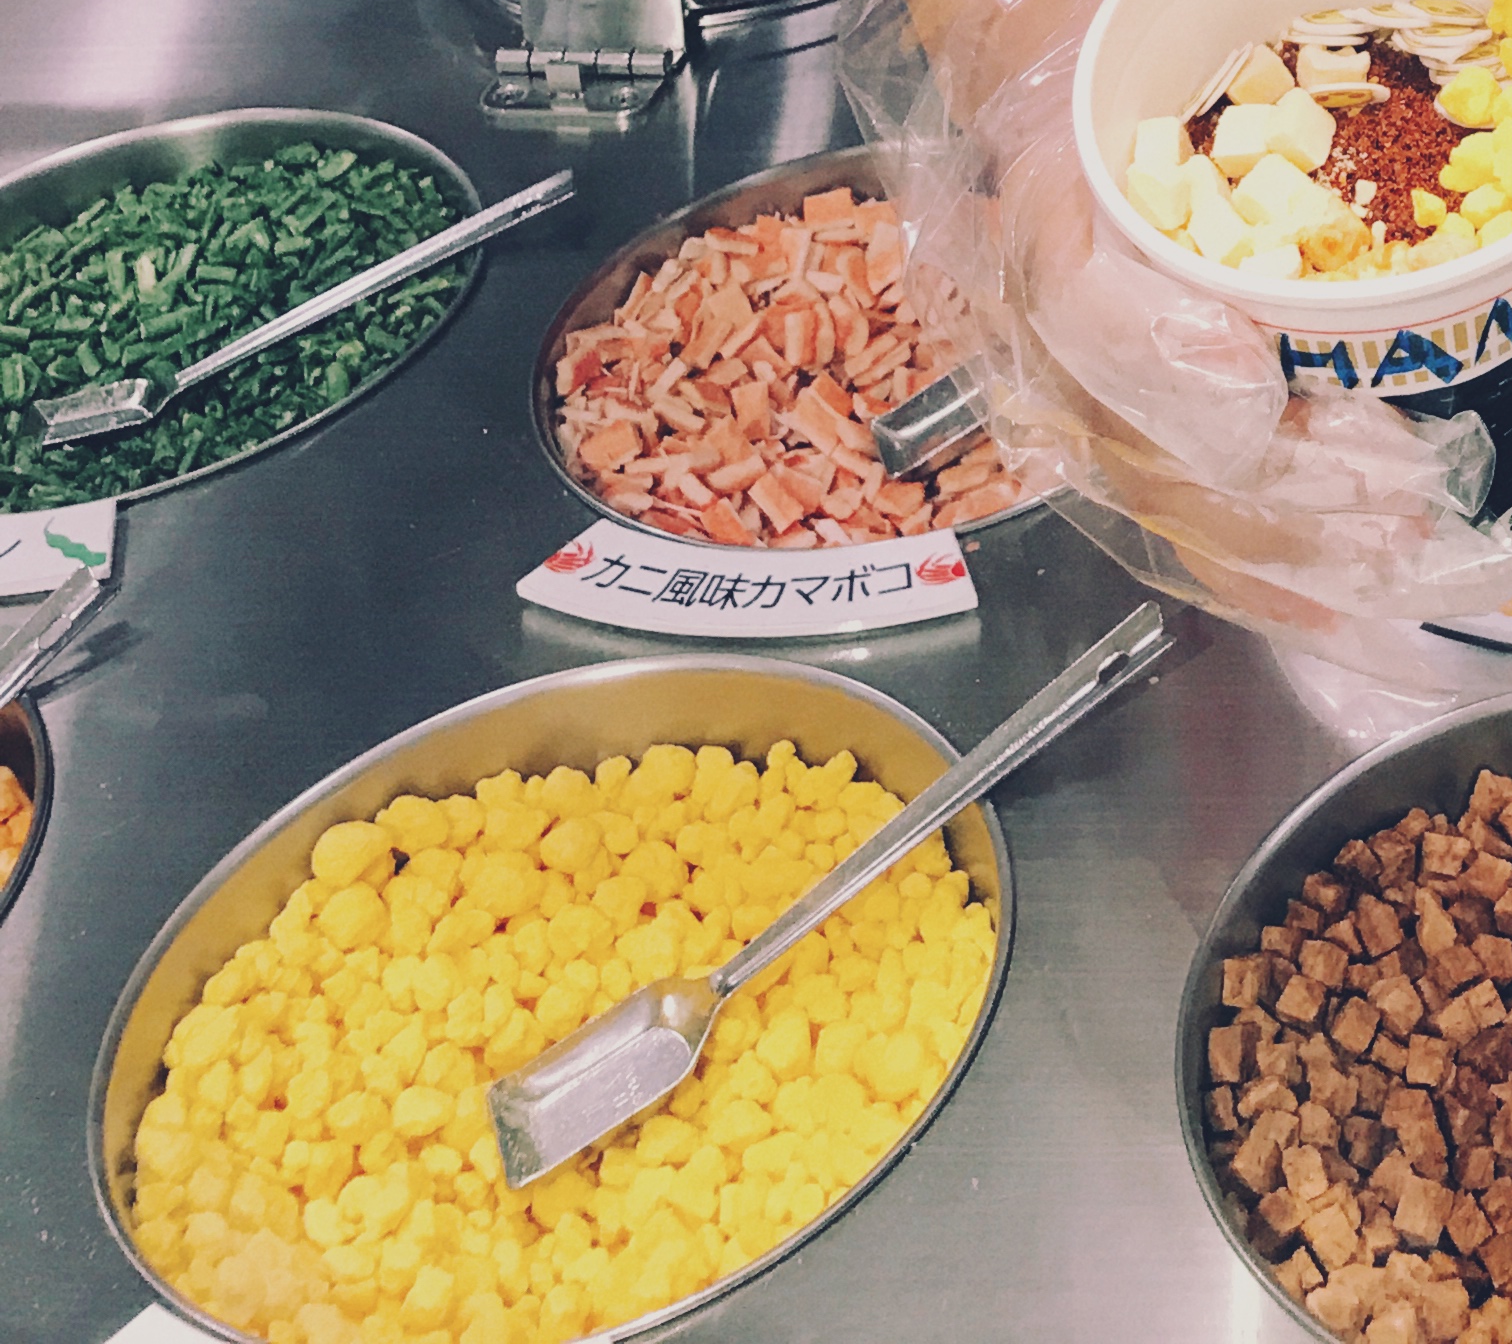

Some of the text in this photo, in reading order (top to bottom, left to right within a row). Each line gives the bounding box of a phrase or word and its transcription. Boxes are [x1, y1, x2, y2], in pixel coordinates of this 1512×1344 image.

[580, 554, 913, 610] カニ風味カマボコ
